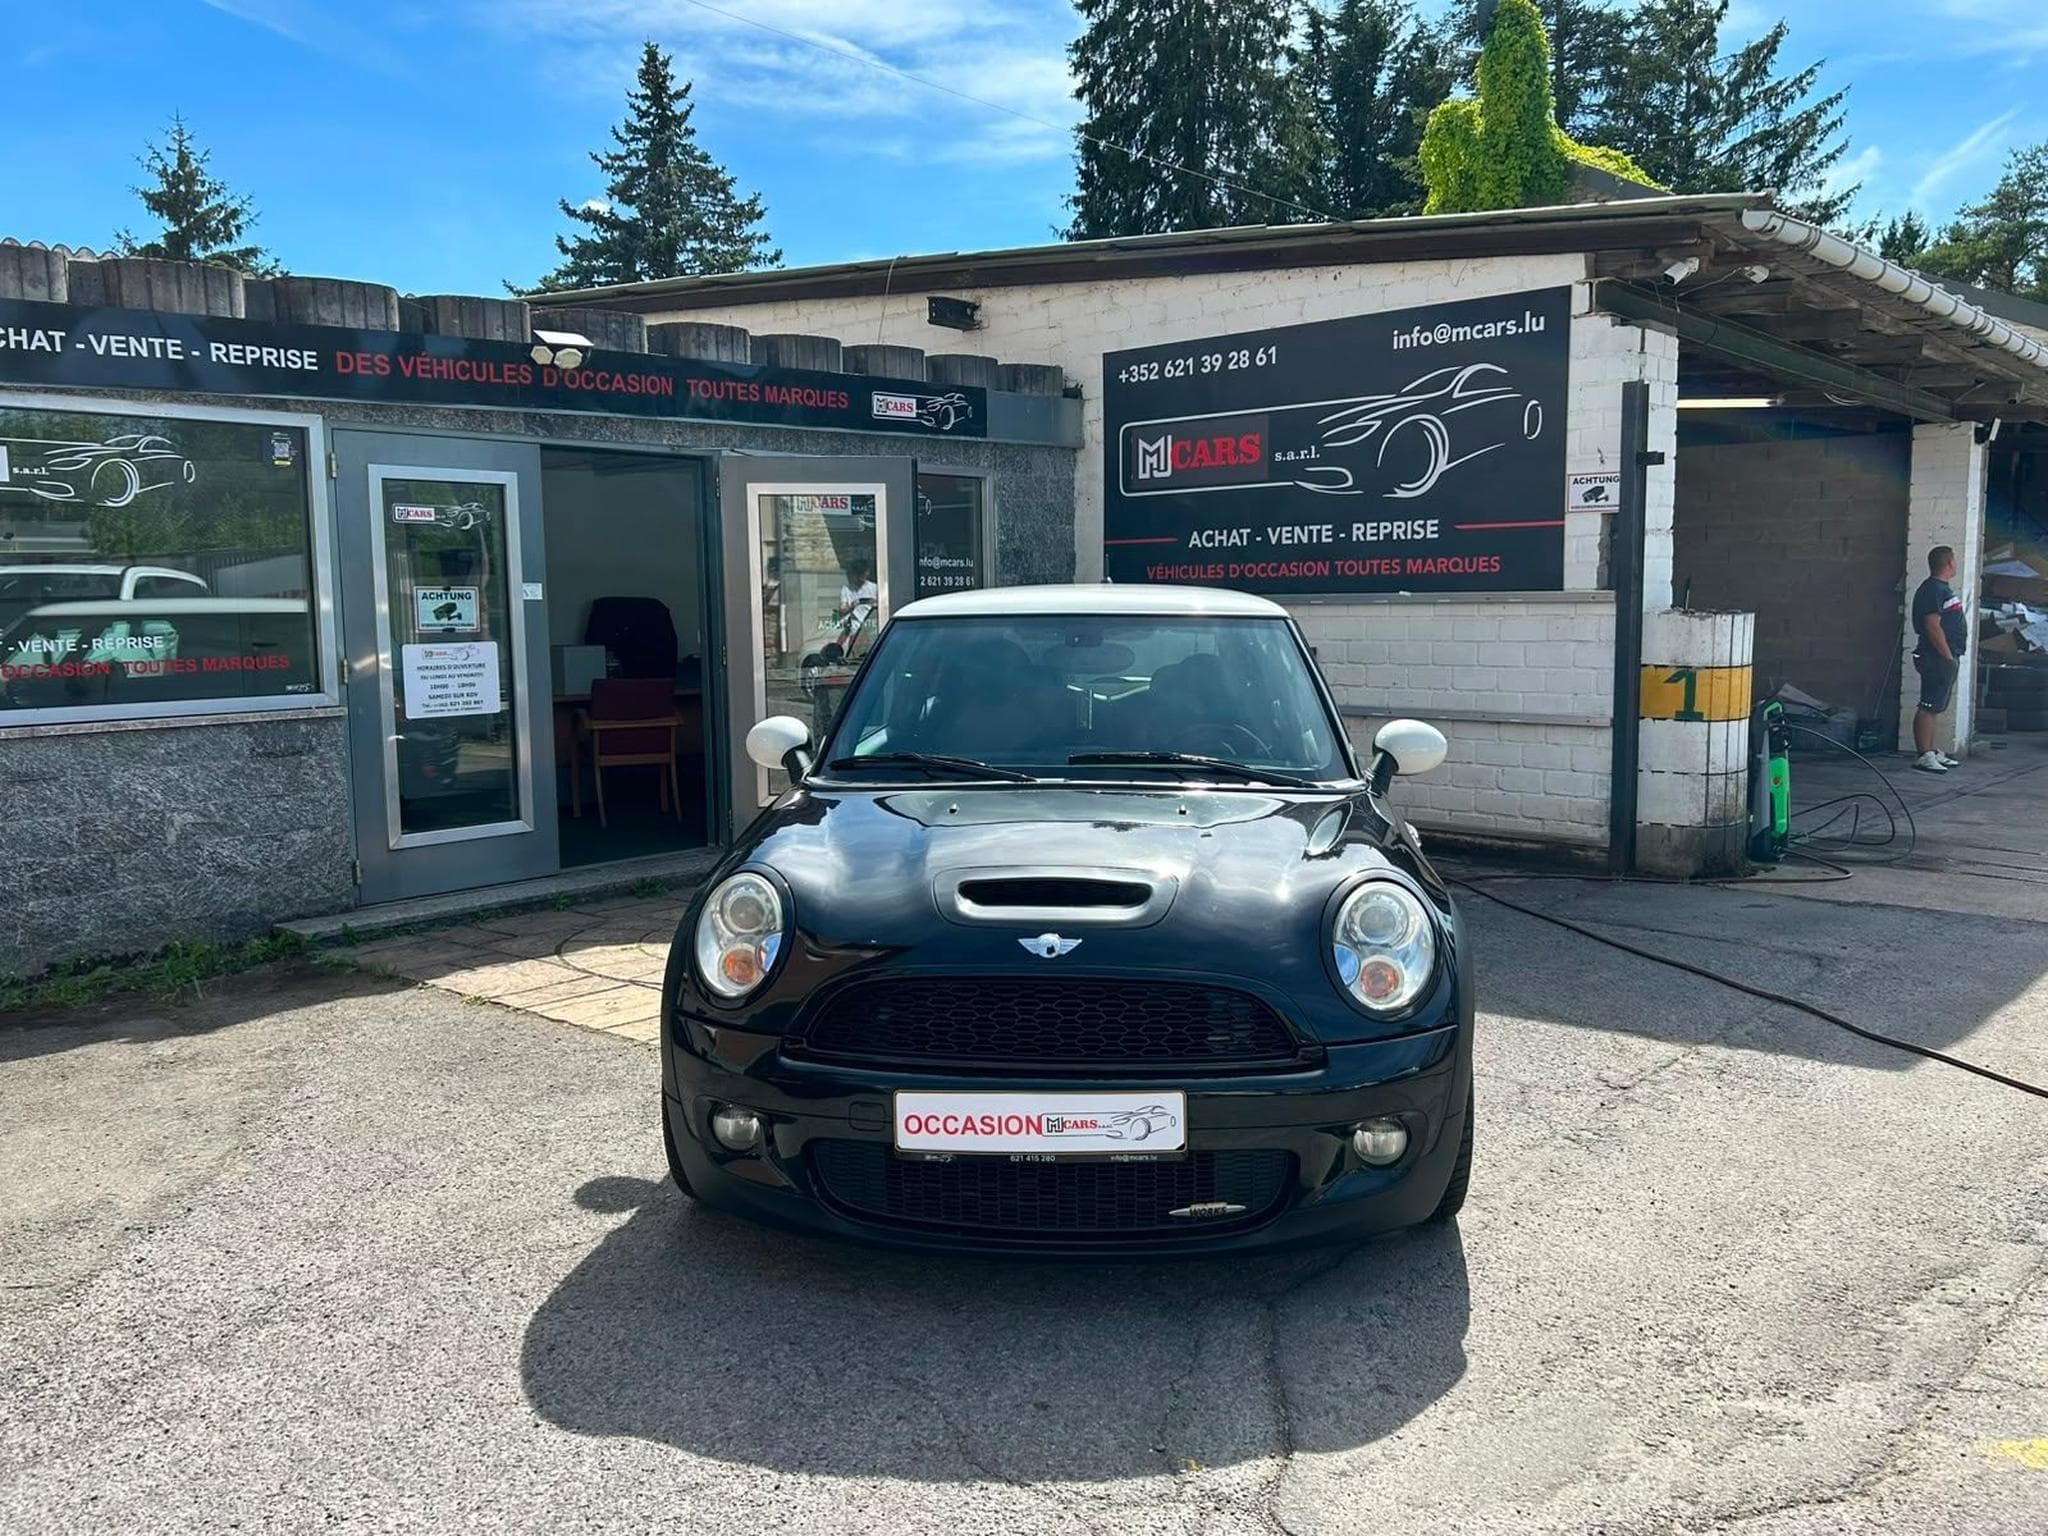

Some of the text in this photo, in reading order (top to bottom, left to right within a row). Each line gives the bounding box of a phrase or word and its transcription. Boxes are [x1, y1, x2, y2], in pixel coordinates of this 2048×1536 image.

[1392, 311, 1546, 350] info@mcars.lu
[211, 342, 318, 370] REPRISE
[1118, 346, 1277, 384] +352 621 39 28 61
[335, 351, 391, 376] DES
[398, 352, 532, 385] VÉHICULES
[687, 379, 760, 402] TOUTES
[765, 386, 849, 409] MARQUES
[1274, 445, 1320, 462] s.a.r.l.
[1573, 475, 1620, 485] ACHTUNG
[1188, 529, 1251, 548] ACHAT
[1267, 525, 1333, 545] VENTE
[1352, 520, 1440, 542] REPRISE
[1147, 556, 1501, 580] VÉHICULES D'OCCASION TOUTES MARQUES
[927, 576, 941, 586] 621
[943, 576, 953, 586] 39
[955, 576, 964, 586] 28
[966, 576, 975, 586] 61
[422, 592, 472, 600] ACHTUNG
[18, 639, 78, 652] VENTE
[92, 636, 164, 649] REPRISE
[124, 657, 197, 675] TOUTES
[203, 655, 289, 671] MARQUES
[1663, 668, 1704, 720] 1
[904, 1114, 1042, 1136] OCCASION
[1010, 1154, 1024, 1162] 621
